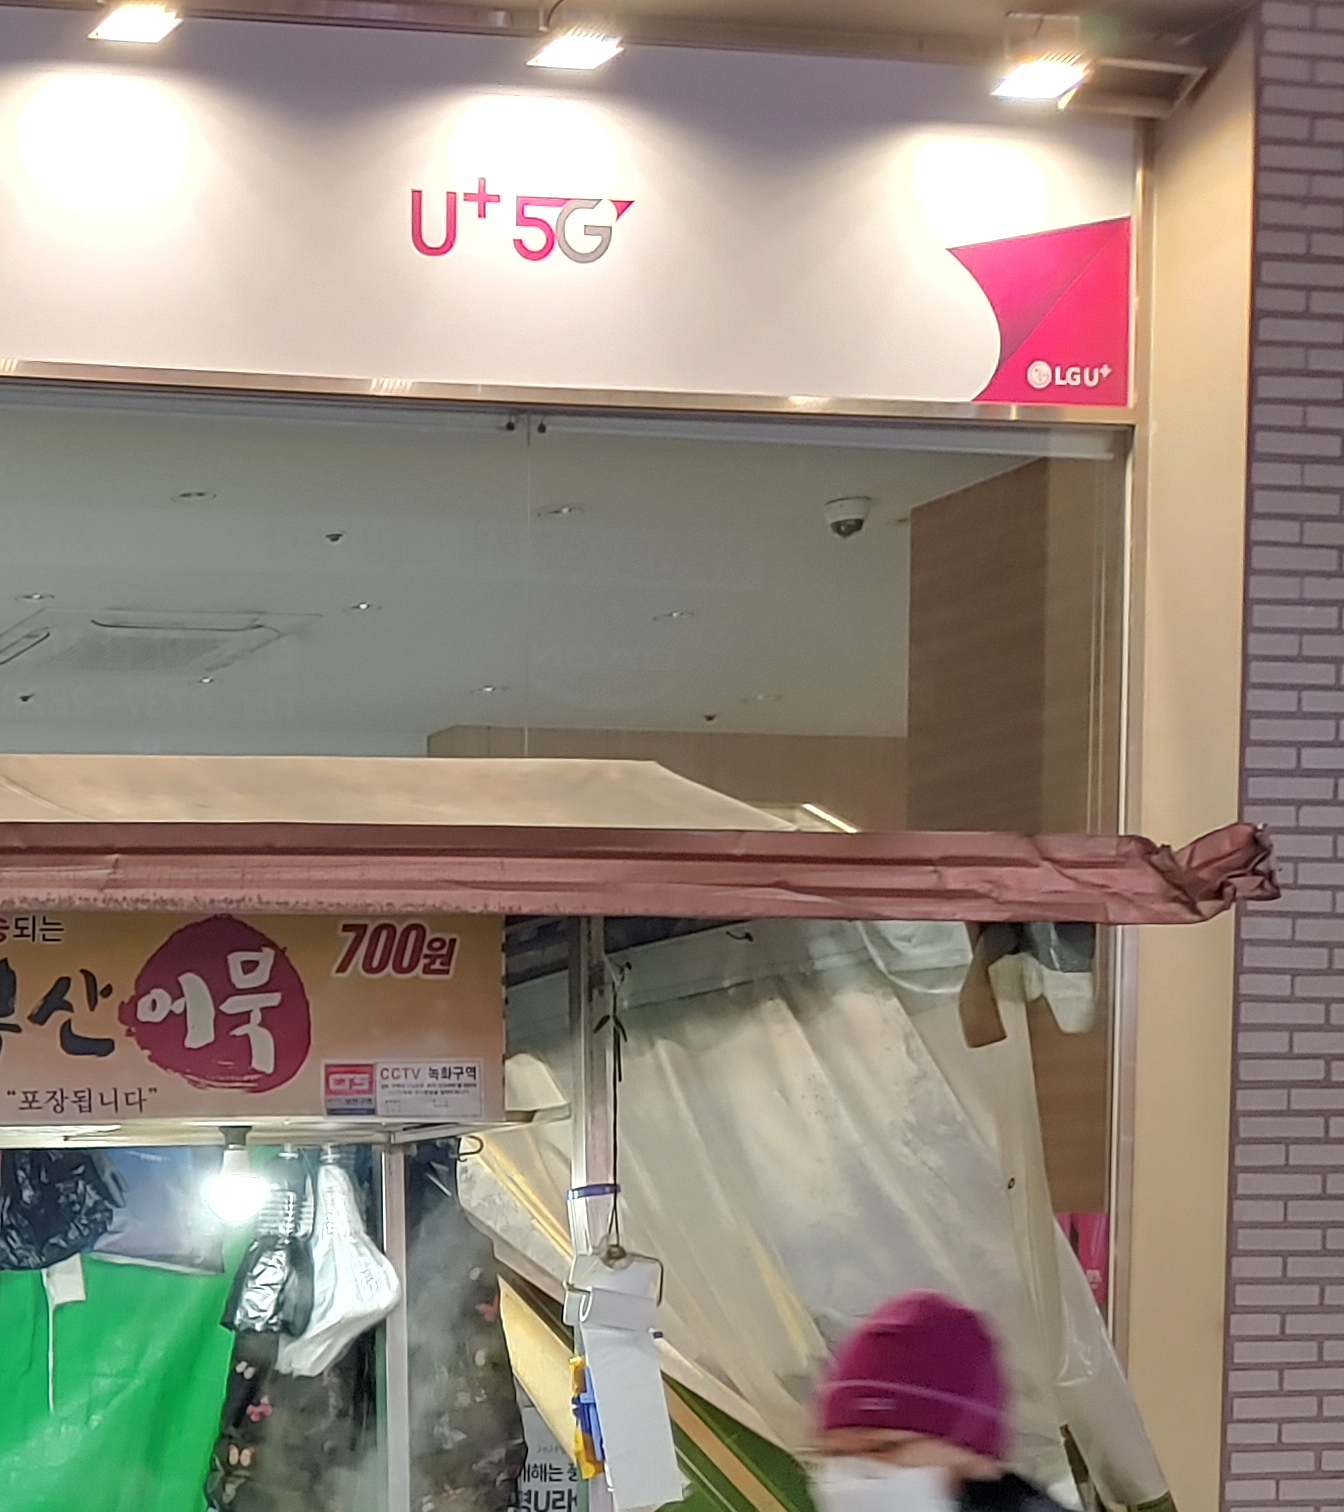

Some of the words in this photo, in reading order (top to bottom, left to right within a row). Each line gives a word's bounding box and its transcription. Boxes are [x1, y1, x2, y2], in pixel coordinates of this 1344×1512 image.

[512, 196, 634, 264] 5G
[333, 921, 458, 977] 700원
[379, 1067, 422, 1080] CCTV
[427, 1065, 478, 1082] 녹화구역
